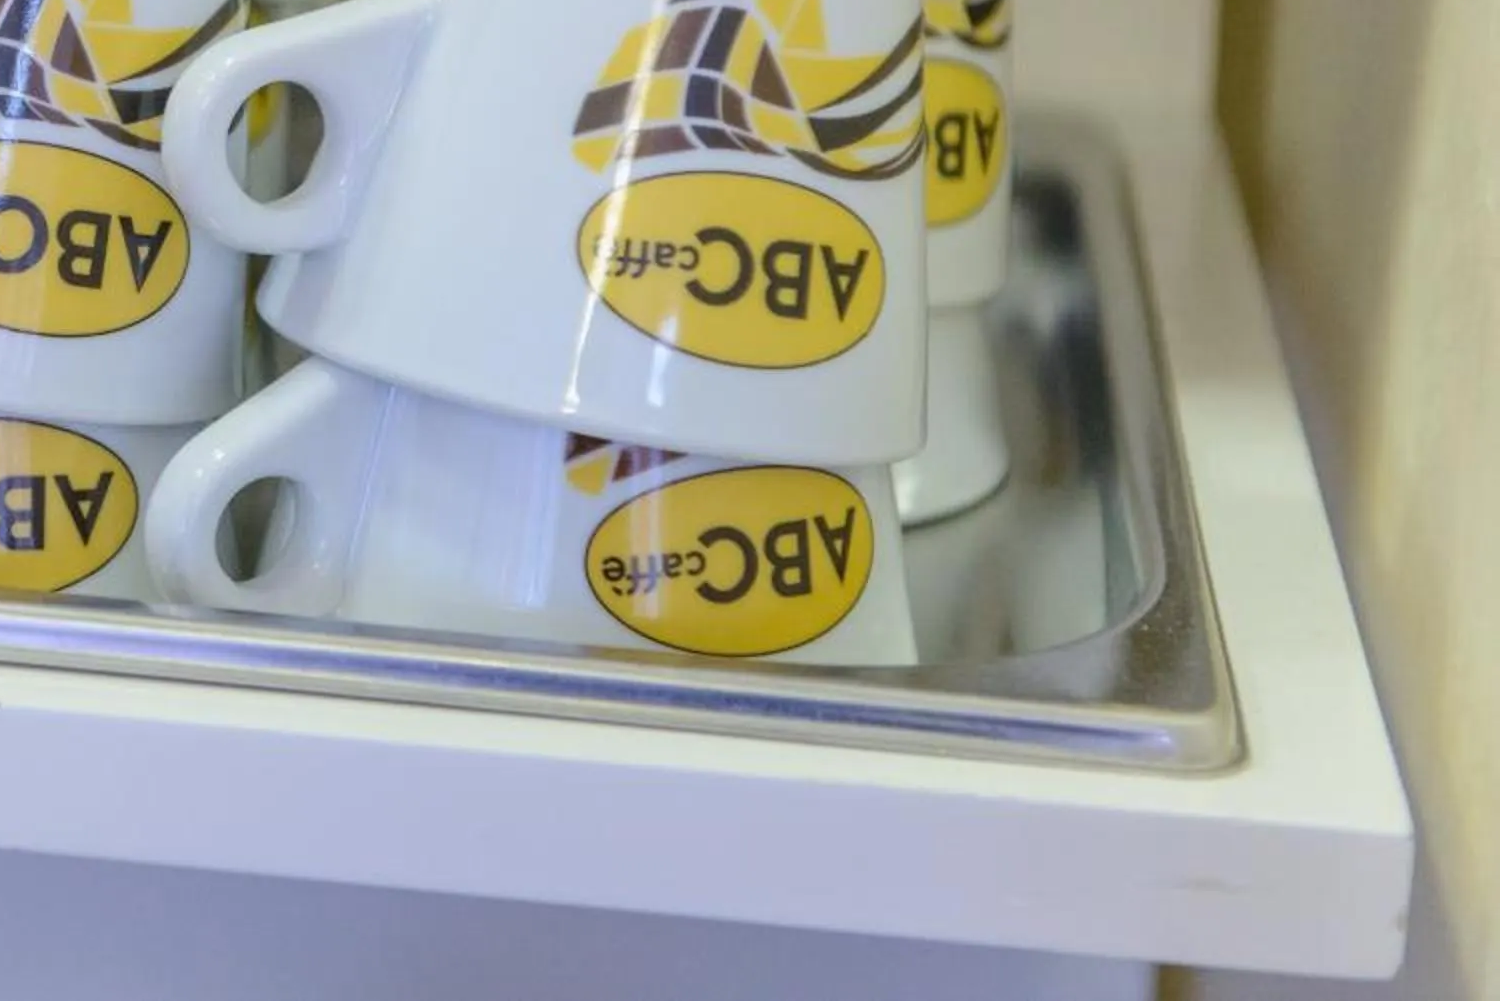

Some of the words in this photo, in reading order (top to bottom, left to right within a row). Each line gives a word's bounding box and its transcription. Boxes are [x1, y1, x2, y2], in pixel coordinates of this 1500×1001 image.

[931, 106, 1000, 181] AB
[685, 226, 870, 323] ABC
[602, 549, 707, 597] caffè
[695, 506, 856, 605] ABC
